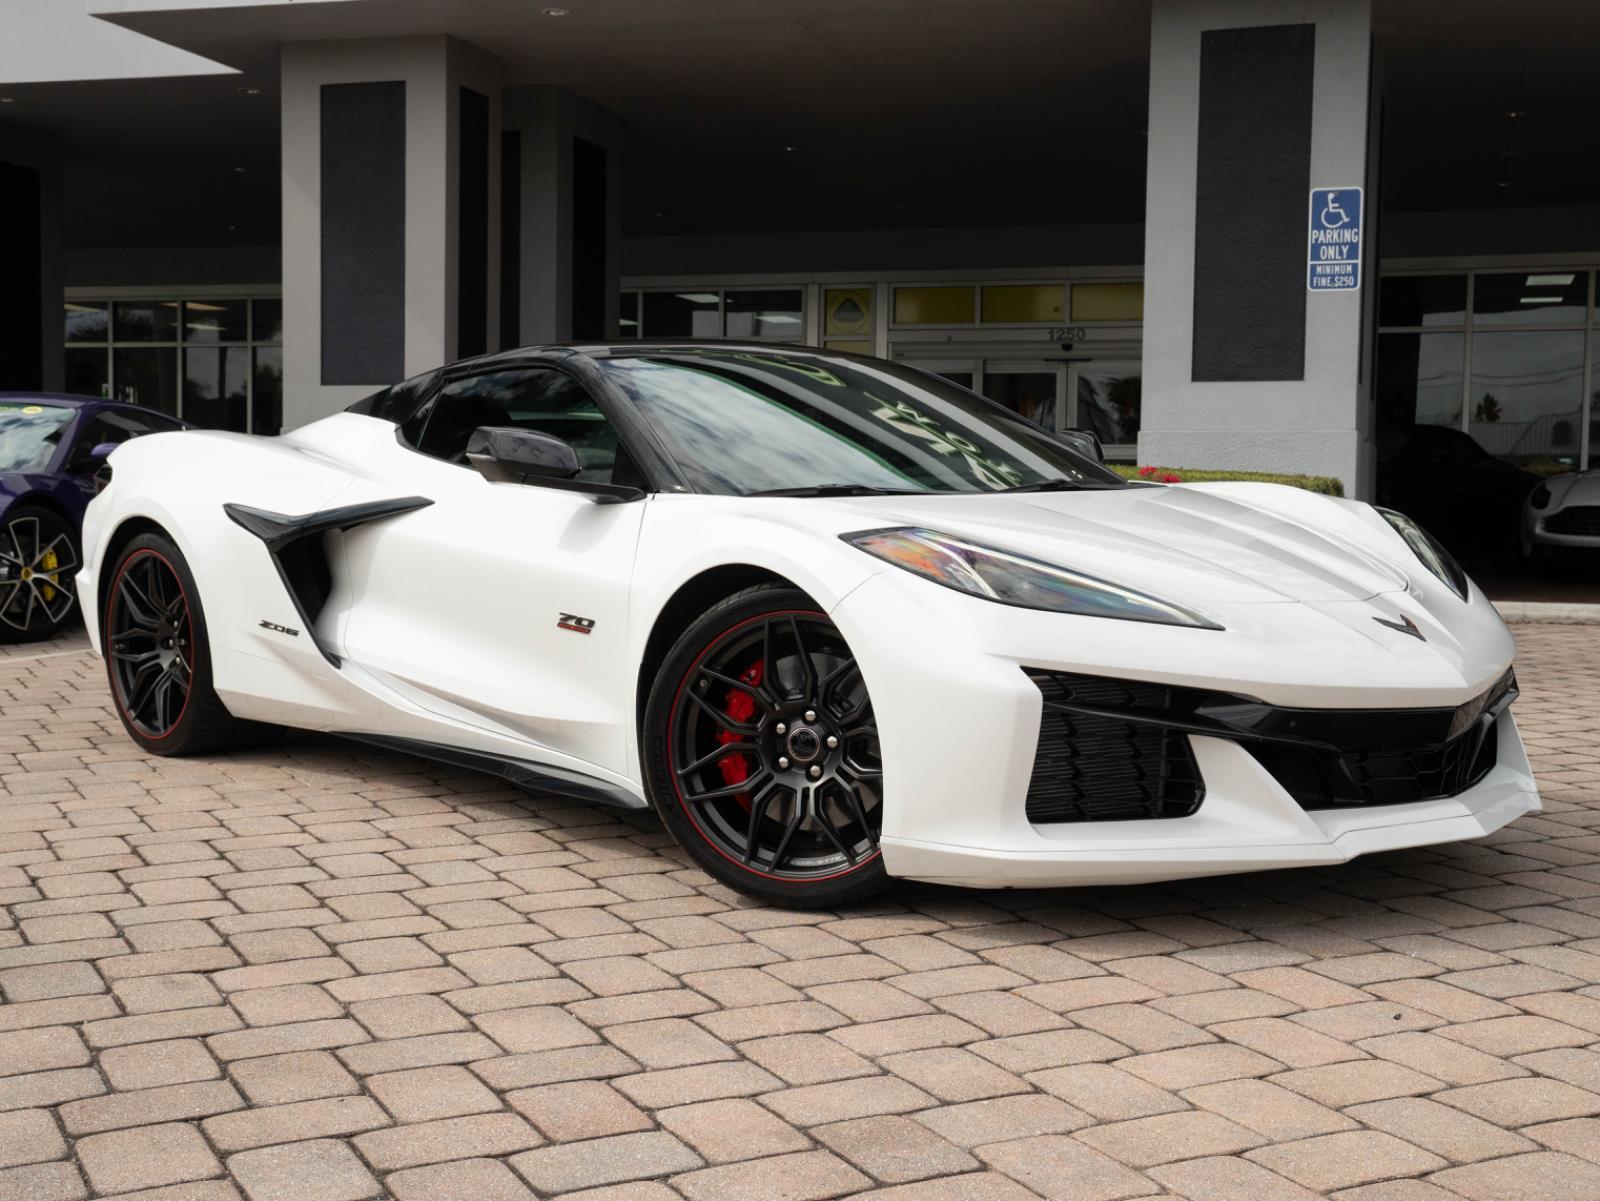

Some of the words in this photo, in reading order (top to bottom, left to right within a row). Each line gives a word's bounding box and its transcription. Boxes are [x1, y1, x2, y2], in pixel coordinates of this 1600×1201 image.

[1312, 228, 1359, 244] PARKING
[1320, 245, 1349, 260] ONLY
[1316, 264, 1353, 275] MINIMUM
[1313, 277, 1331, 287] FINE
[1334, 275, 1355, 287] $250
[1048, 327, 1086, 341] 1250
[258, 620, 300, 636] Z06
[559, 612, 596, 629] 70
